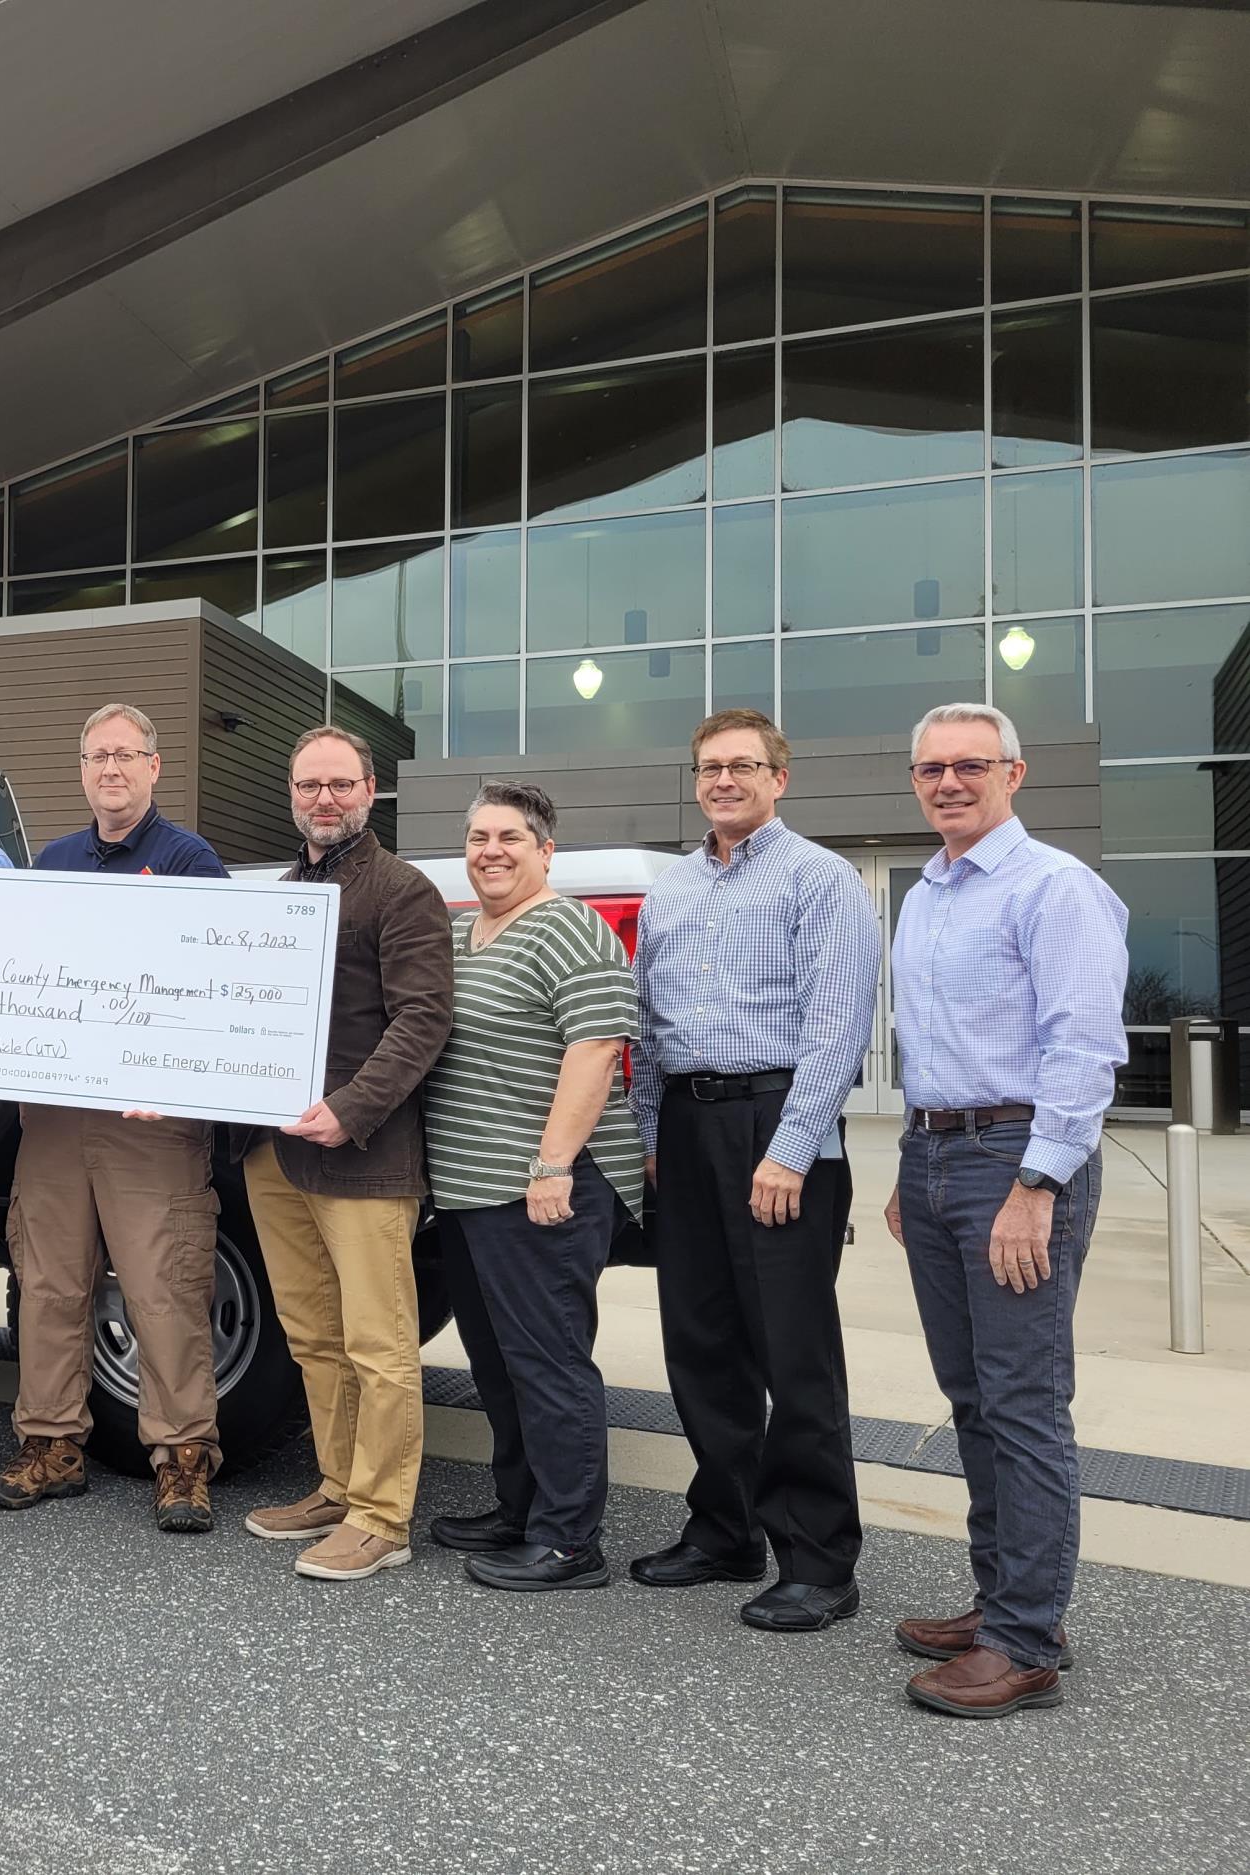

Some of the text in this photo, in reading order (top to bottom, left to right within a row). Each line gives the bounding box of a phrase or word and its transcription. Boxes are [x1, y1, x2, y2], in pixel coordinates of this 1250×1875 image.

[286, 904, 316, 916] 5789
[180, 934, 199, 944] Date:
[206, 927, 298, 952] Dec. 8, 2022
[3, 957, 49, 999] County
[57, 965, 131, 998] Emergency
[139, 973, 218, 1001] Management
[220, 984, 229, 997] $
[235, 985, 283, 1004] 25,000
[229, 1024, 255, 1035] Dollars
[25, 1036, 67, 1058] (UTV)
[122, 1050, 295, 1078] Duke Energy Foundation
[85, 1076, 109, 1085] 5789
